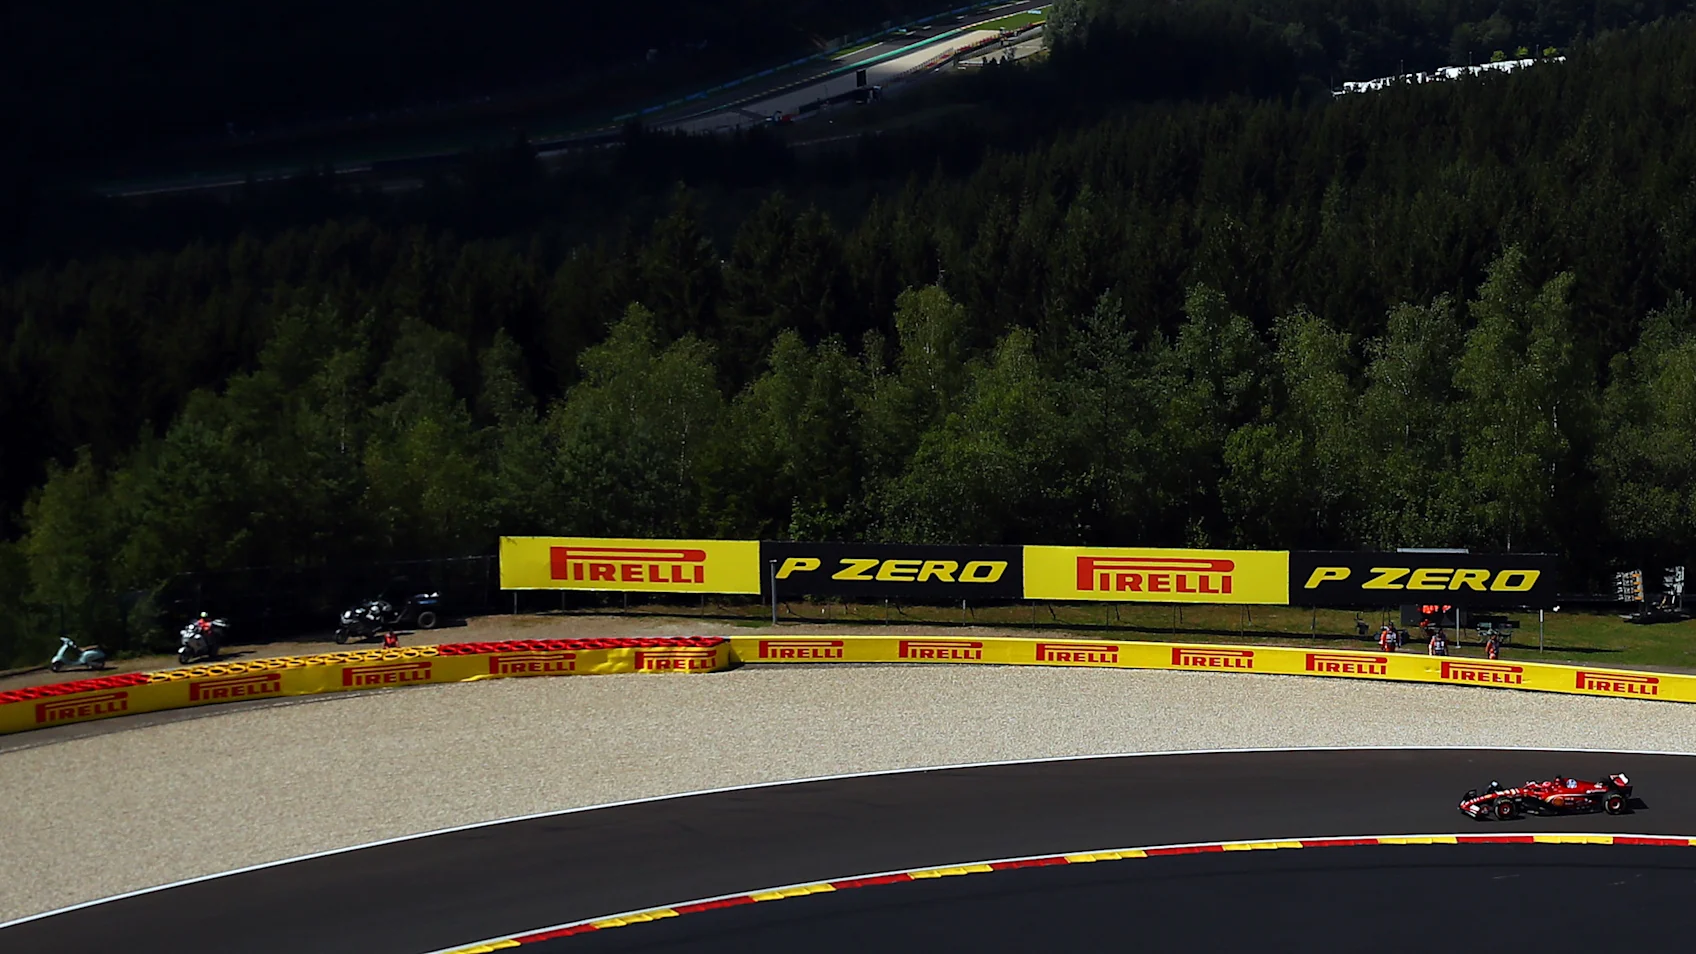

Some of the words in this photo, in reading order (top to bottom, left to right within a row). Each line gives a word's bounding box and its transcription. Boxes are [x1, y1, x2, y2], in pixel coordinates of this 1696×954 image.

[551, 547, 706, 584] PIRELLI
[776, 558, 819, 578] P
[833, 559, 1007, 582] ZERO
[1077, 557, 1234, 594] PIRELLI
[1305, 567, 1350, 588] P
[1363, 568, 1540, 591] ZERO
[634, 649, 716, 671] PIRELLI
[759, 640, 844, 658] PIRELLI
[899, 640, 982, 659] PIRELLI
[1036, 644, 1118, 663] PIRELLI
[1172, 648, 1254, 668] PIRELLI
[342, 662, 432, 687] PIRELLI
[489, 651, 577, 675] PIRELLI
[1306, 653, 1388, 675] PIRELLI
[1441, 661, 1523, 684] PIRELLI
[189, 673, 281, 701] PIRELLI
[1576, 671, 1659, 695] PIRELLI
[35, 691, 128, 723] PIRELLI
